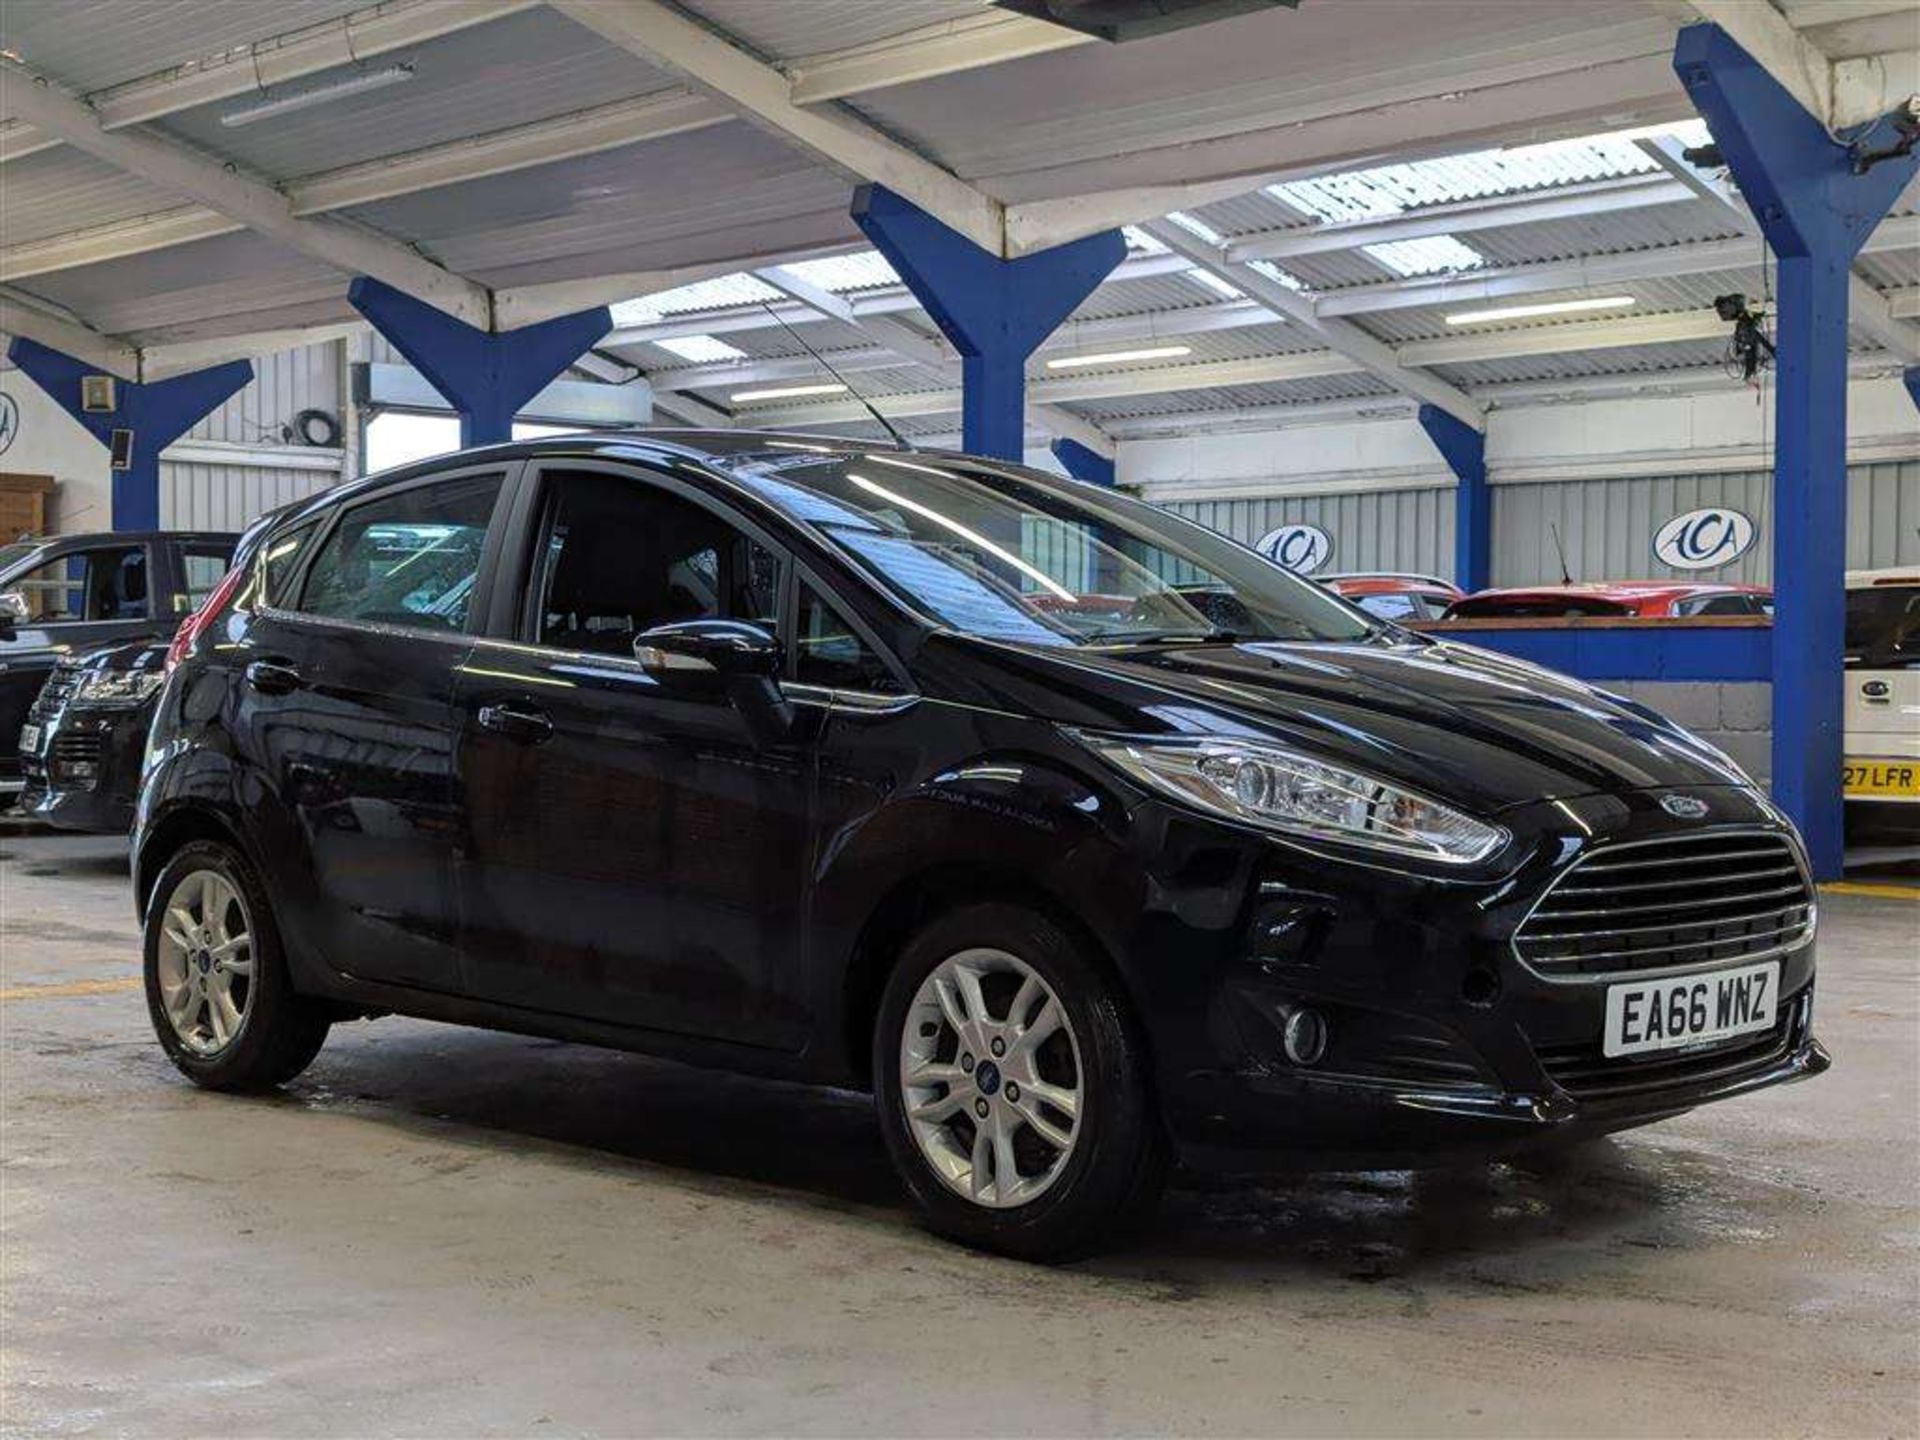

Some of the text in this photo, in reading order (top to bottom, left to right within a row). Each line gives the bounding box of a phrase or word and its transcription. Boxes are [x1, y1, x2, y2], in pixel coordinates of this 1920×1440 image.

[1264, 530, 1317, 569] ACA
[1660, 513, 1738, 561] ACA
[1843, 767, 1913, 787] 27 LFR
[1621, 972, 1768, 1045] EA66 WNZ
